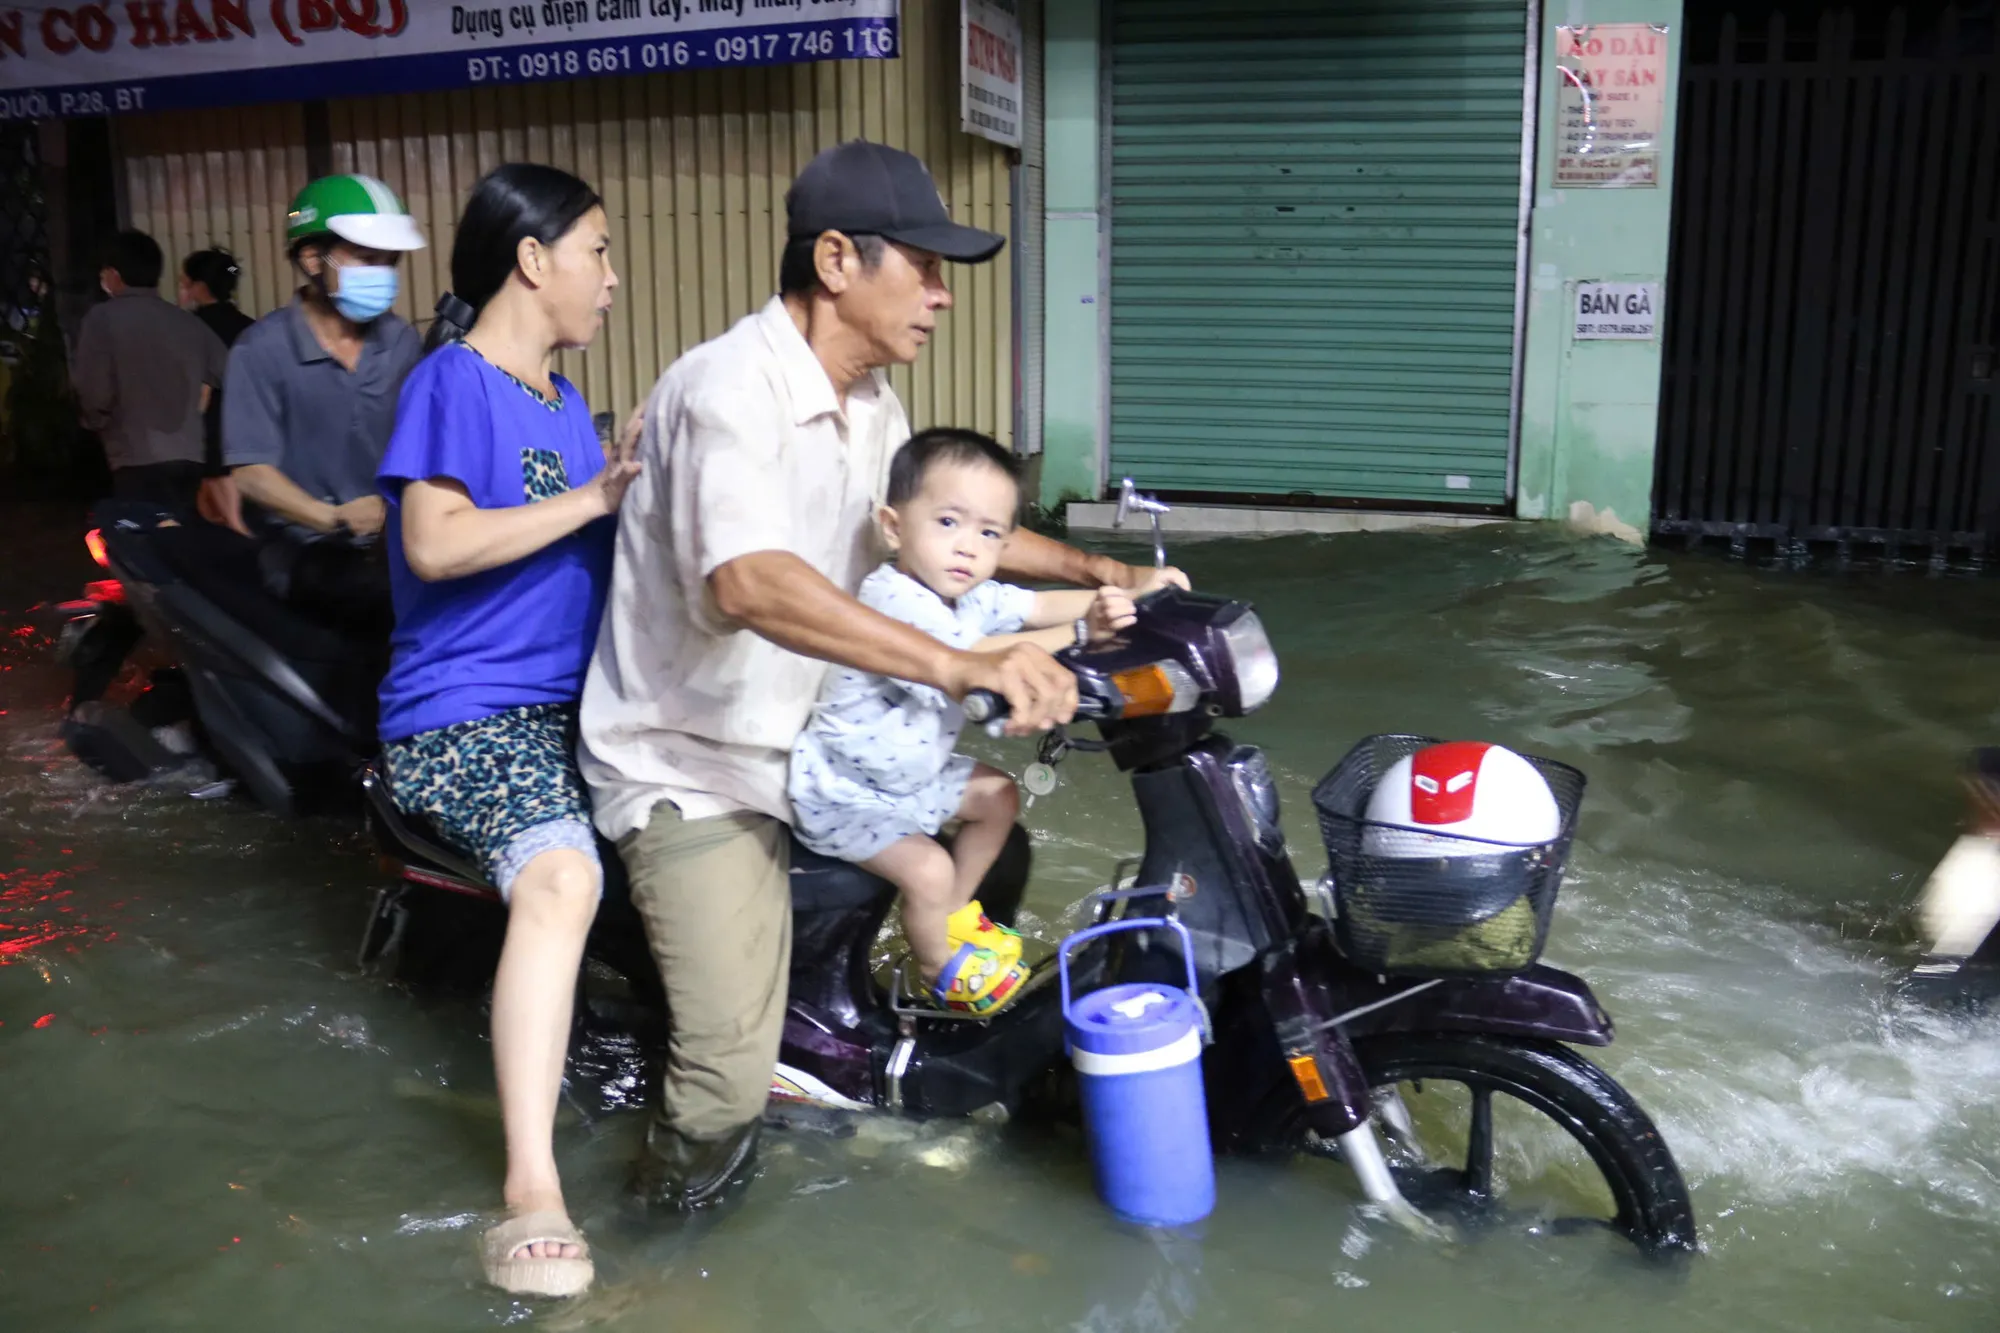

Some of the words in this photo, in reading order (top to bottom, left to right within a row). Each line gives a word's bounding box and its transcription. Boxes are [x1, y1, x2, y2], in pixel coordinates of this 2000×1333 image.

[451, 6, 504, 41] Dụng
[508, 5, 537, 36] cụ
[468, 57, 511, 82] ĐT:
[518, 51, 580, 78] 0918
[586, 47, 633, 73] 661
[641, 41, 690, 69] 016
[714, 35, 780, 62] 0917
[788, 31, 834, 56] 746
[843, 26, 893, 53] 116
[115, 87, 146, 110] BT
[1580, 288, 1620, 315] BÁN
[1625, 288, 1652, 315] GÀ
